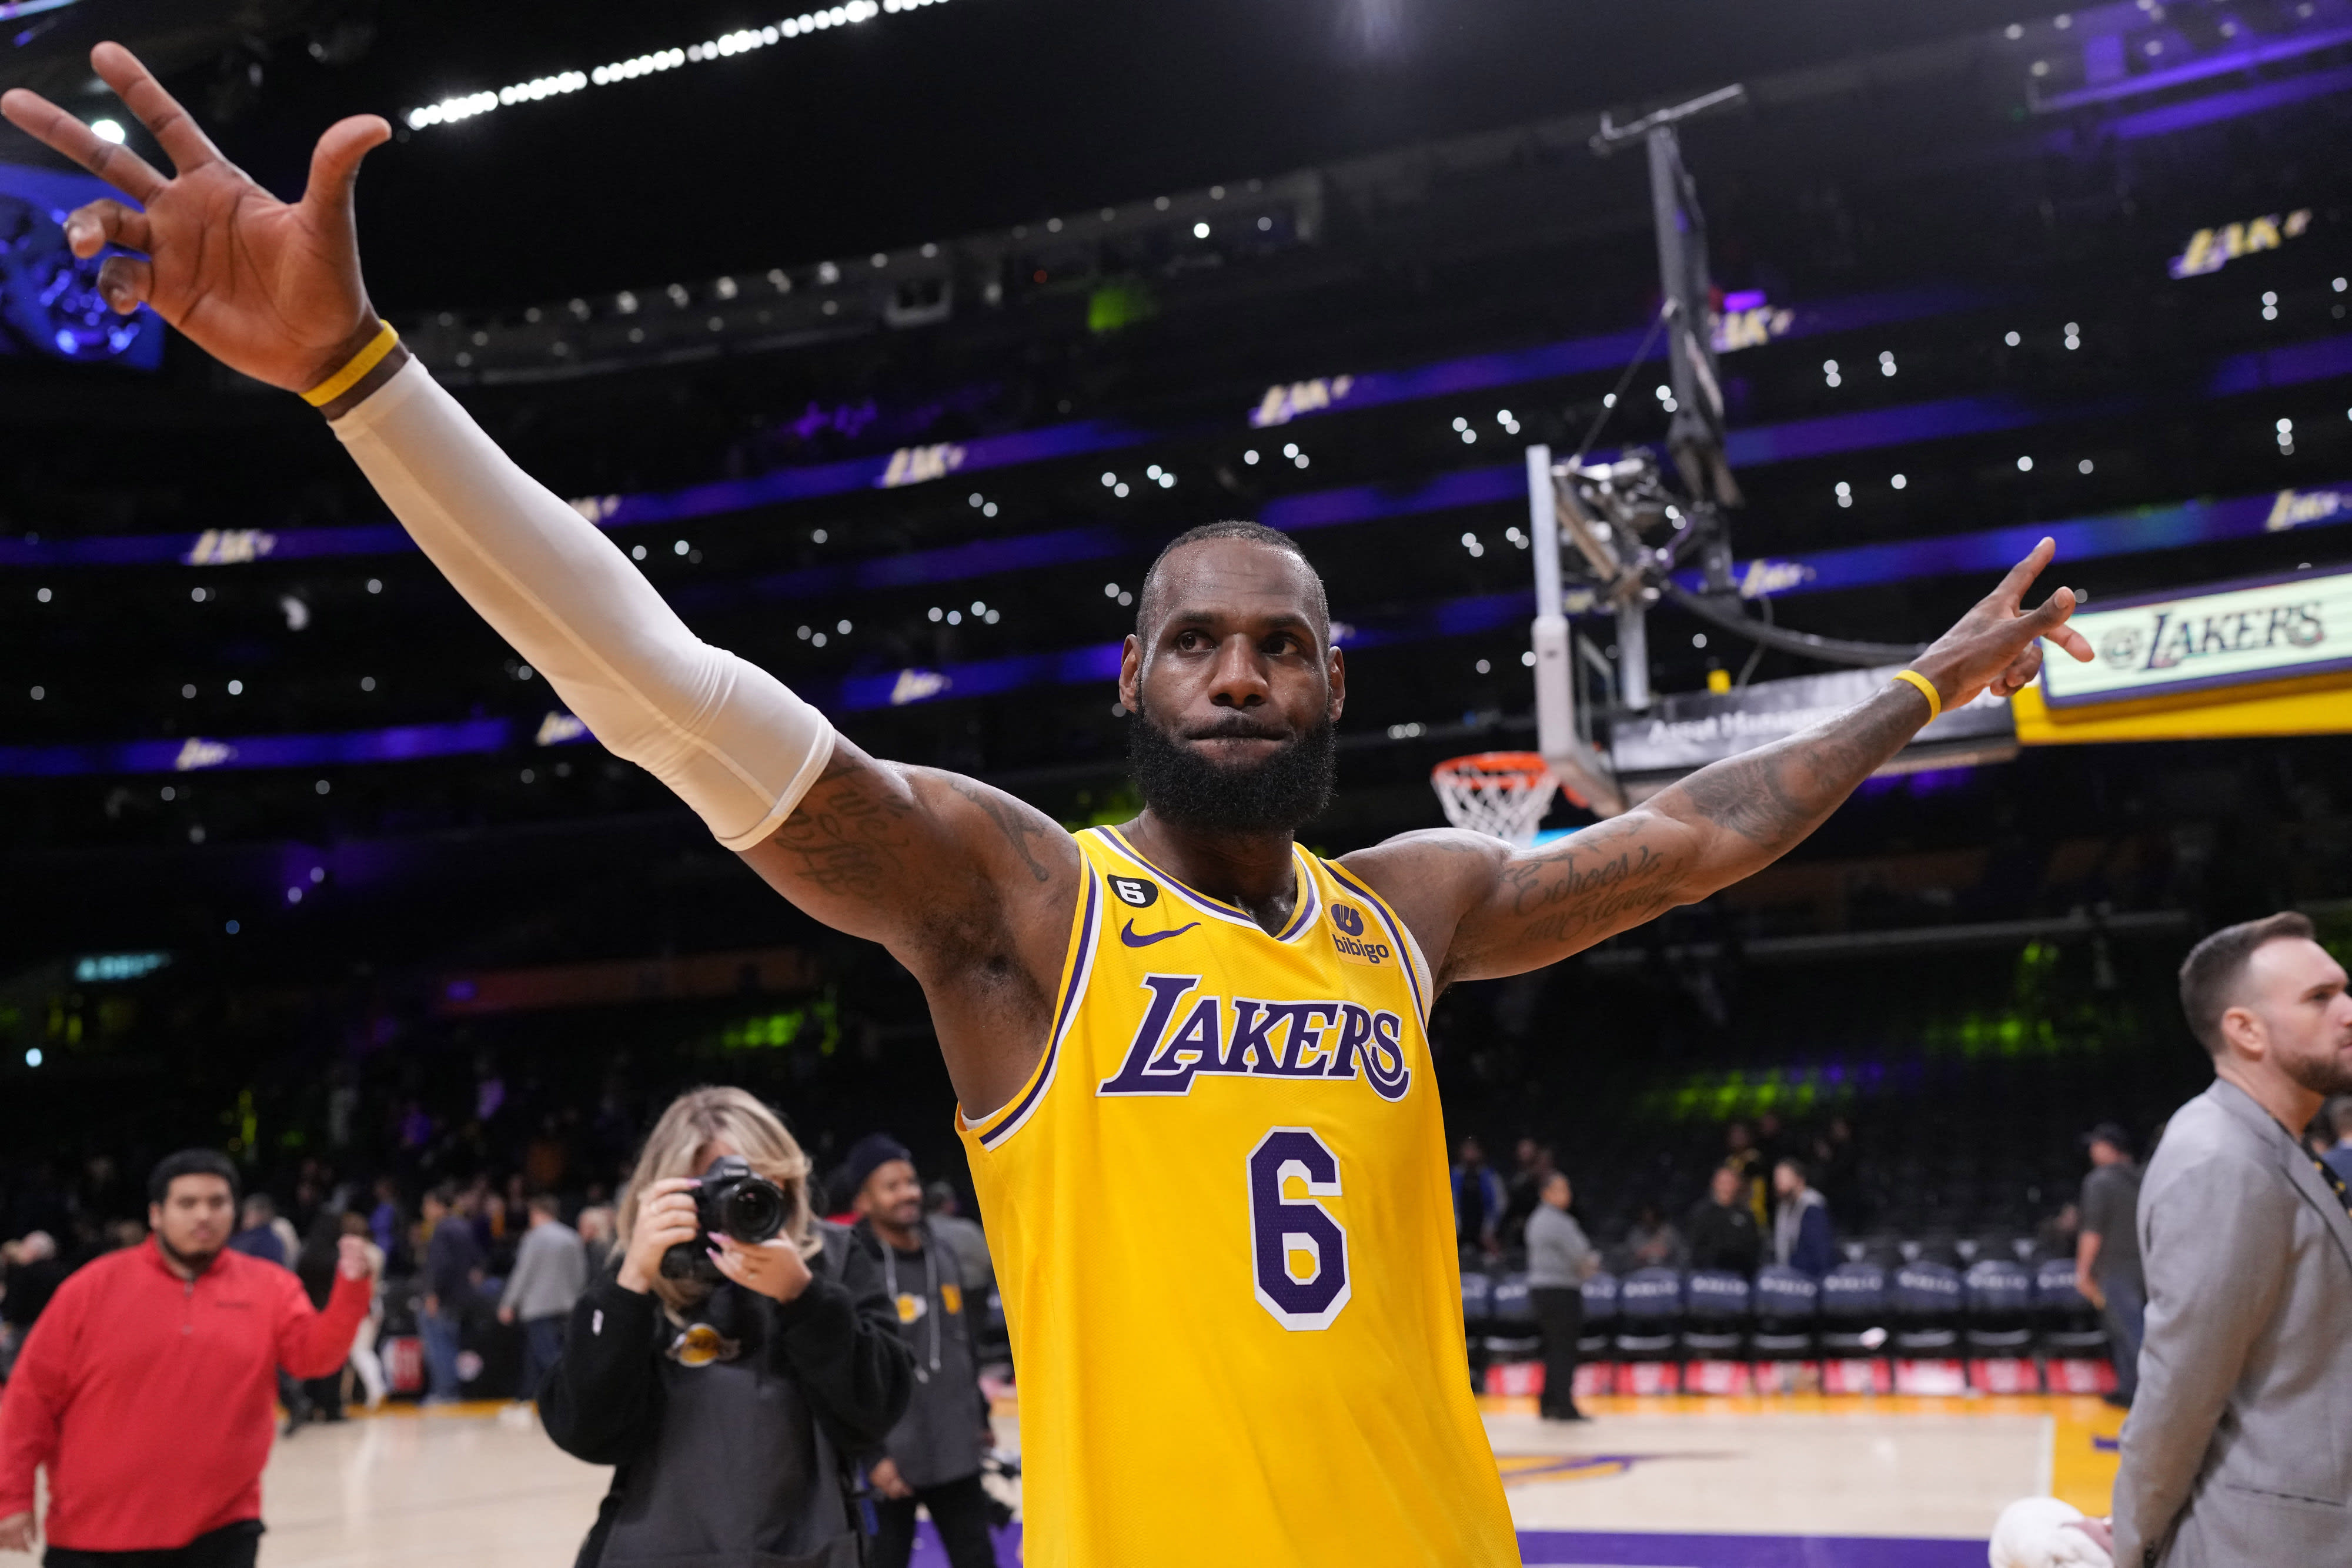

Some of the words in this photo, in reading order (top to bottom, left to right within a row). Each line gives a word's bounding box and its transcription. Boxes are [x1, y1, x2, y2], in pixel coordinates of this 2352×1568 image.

[2140, 600, 2327, 671] LAKERS
[1116, 881, 1145, 905] 6
[1332, 934, 1389, 964] bibigo
[1095, 972, 1411, 1102] LAKERS
[1246, 1125, 1352, 1331] 6
